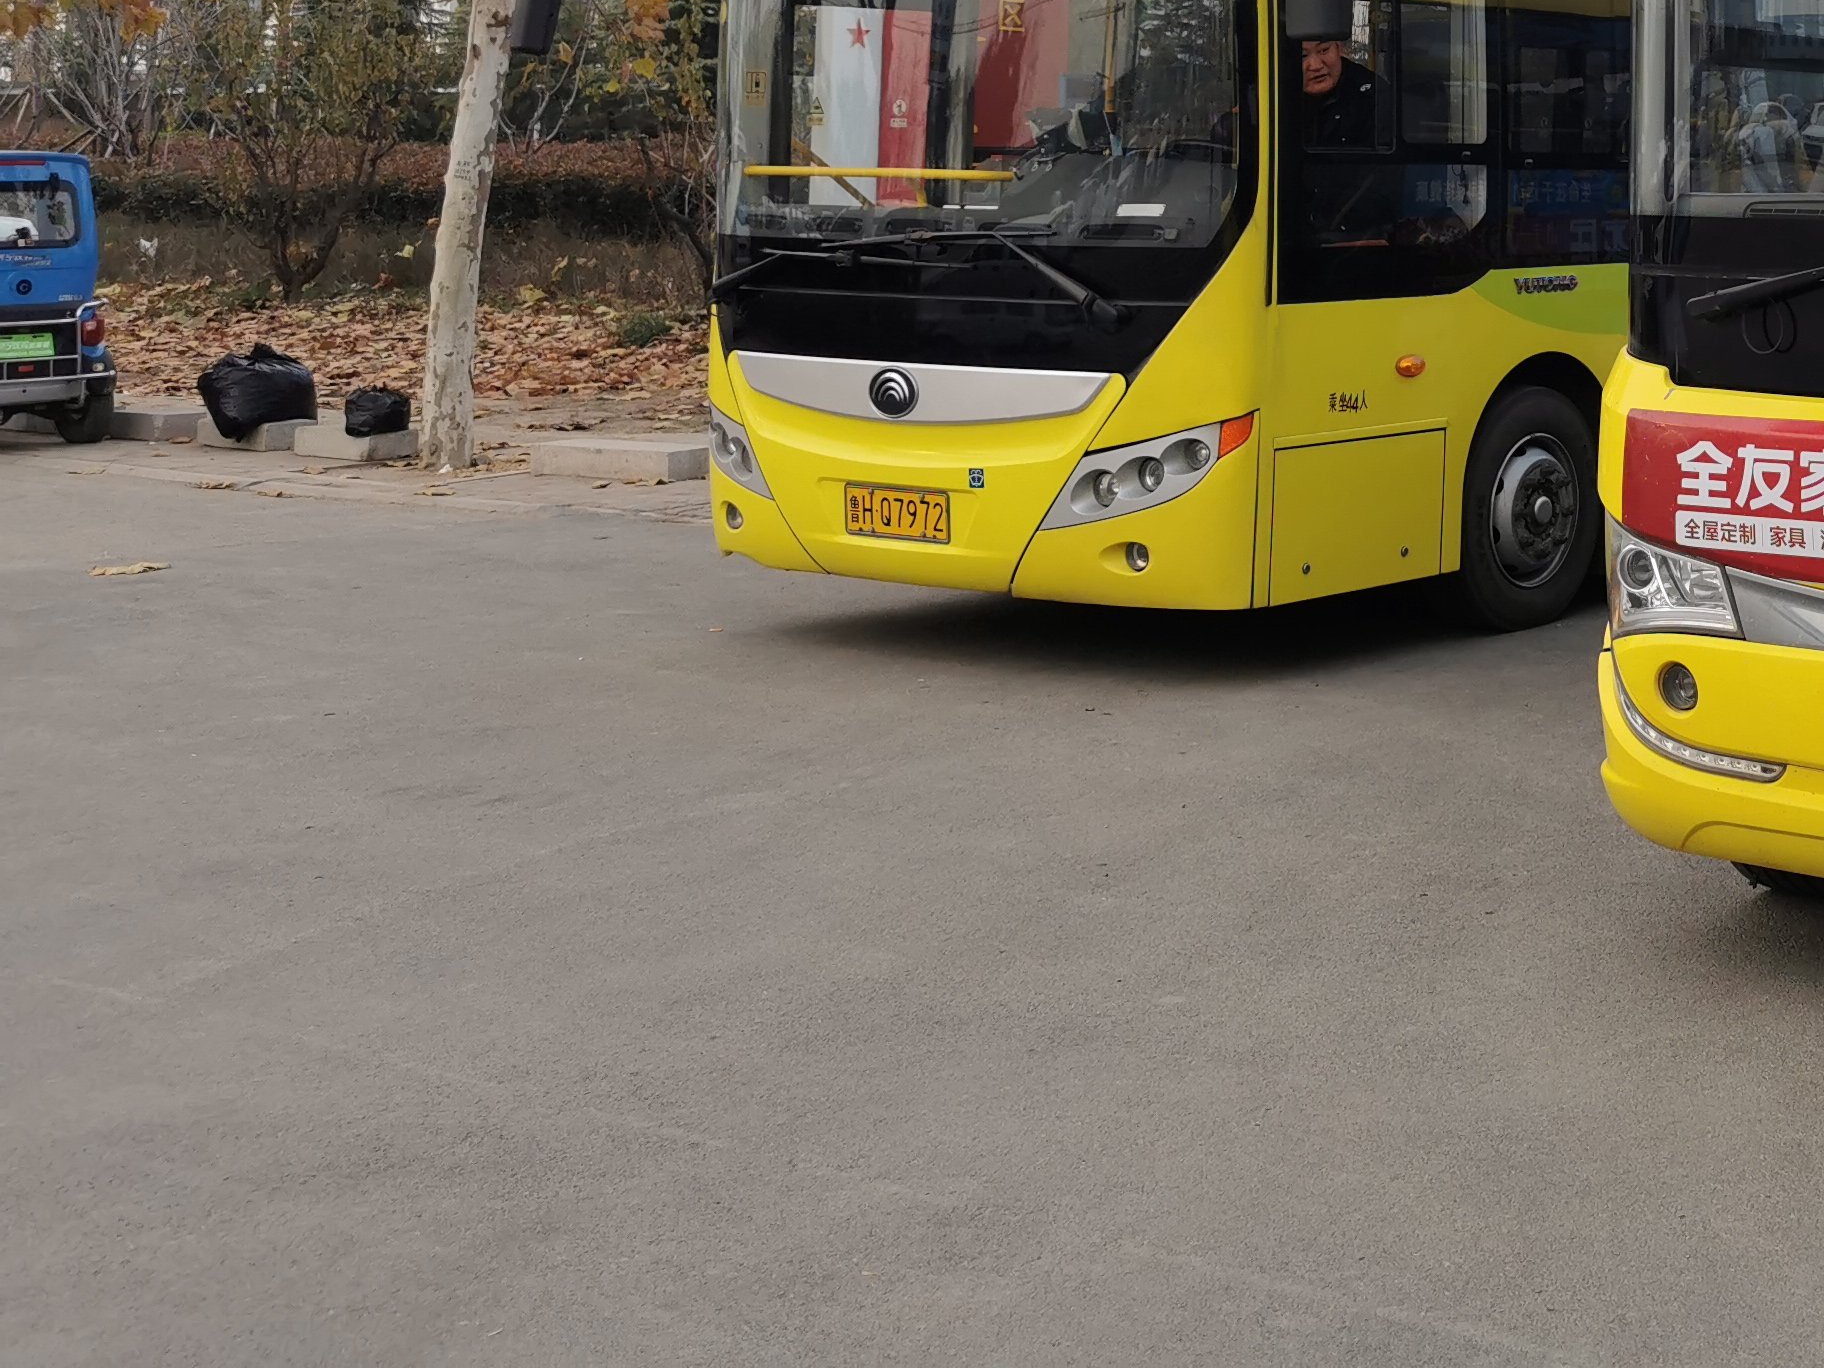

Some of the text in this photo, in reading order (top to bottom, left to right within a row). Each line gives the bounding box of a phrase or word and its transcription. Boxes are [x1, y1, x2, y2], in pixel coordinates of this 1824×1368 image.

[1683, 519, 1757, 546] 全屋定制
[1769, 526, 1807, 549] 家具
